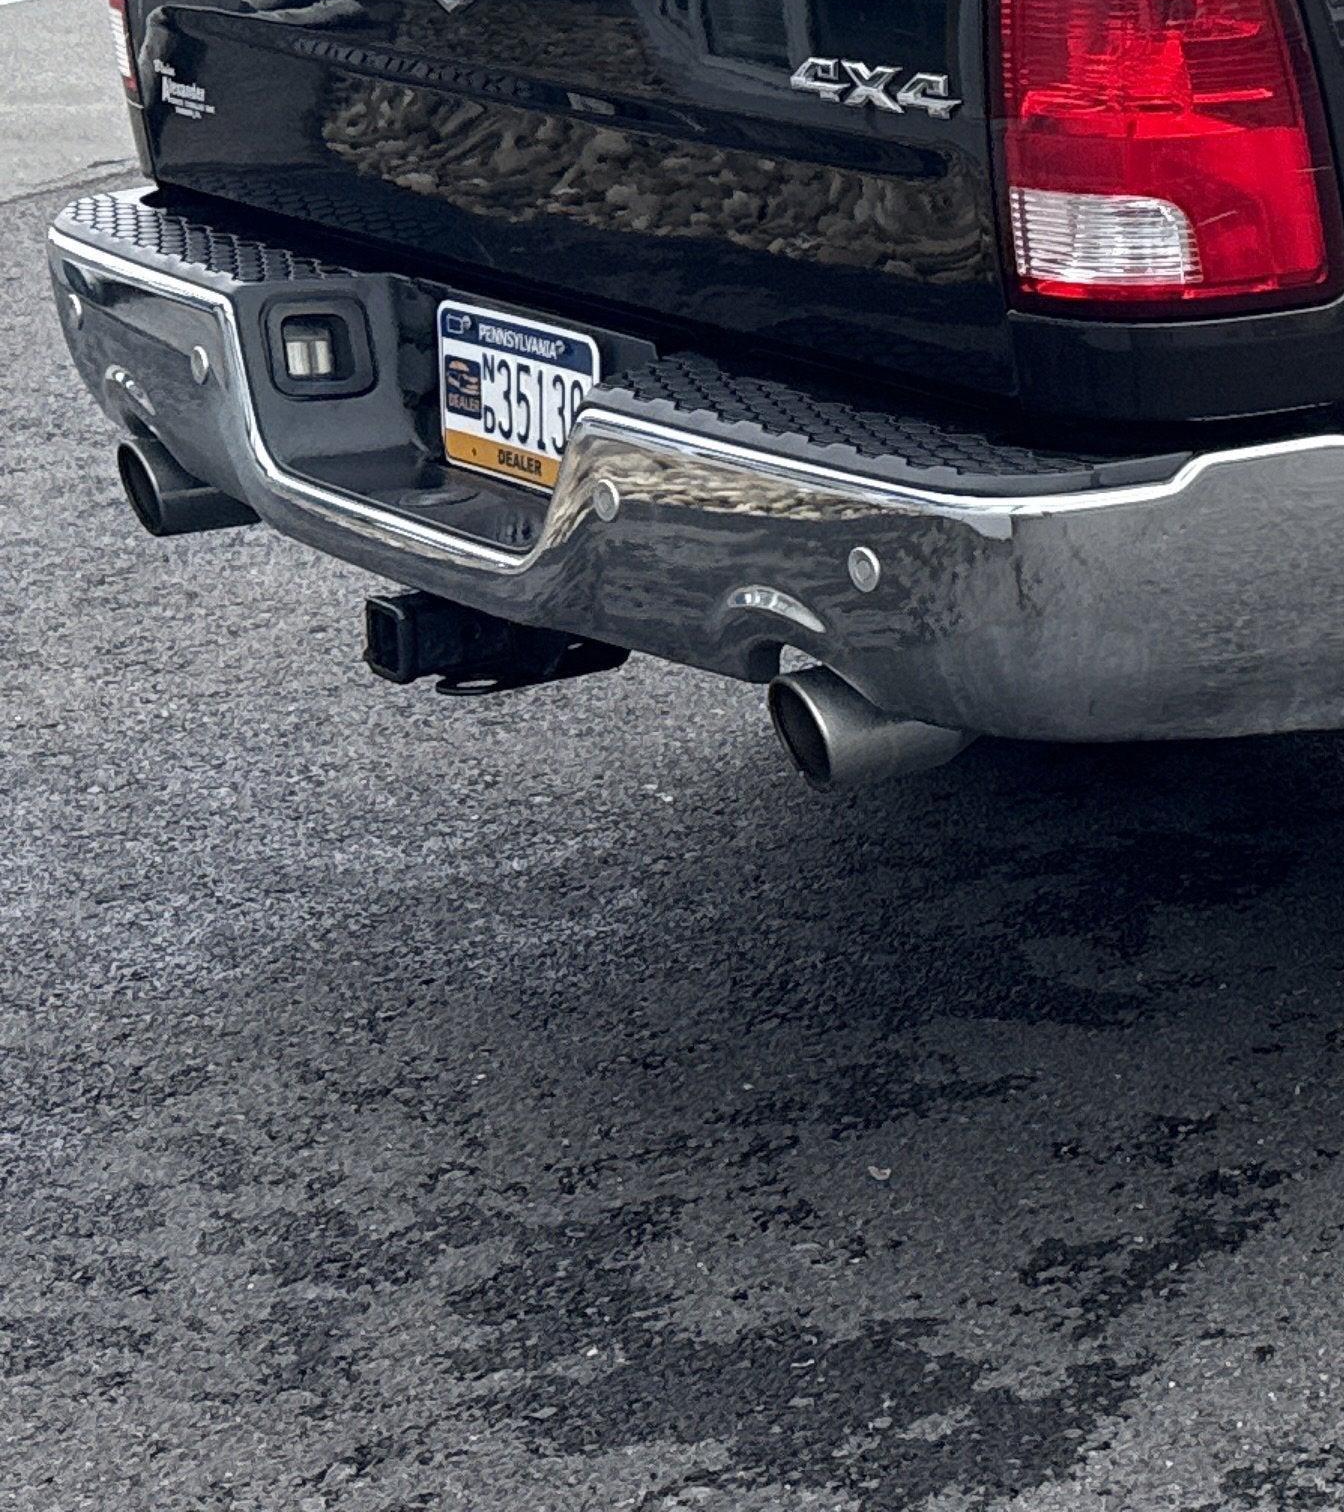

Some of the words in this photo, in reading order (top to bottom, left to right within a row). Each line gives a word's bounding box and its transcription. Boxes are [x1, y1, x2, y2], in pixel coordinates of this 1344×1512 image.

[478, 323, 558, 360] PENNSYLVANIA
[482, 352, 495, 384] N
[498, 448, 543, 477] DEALER
